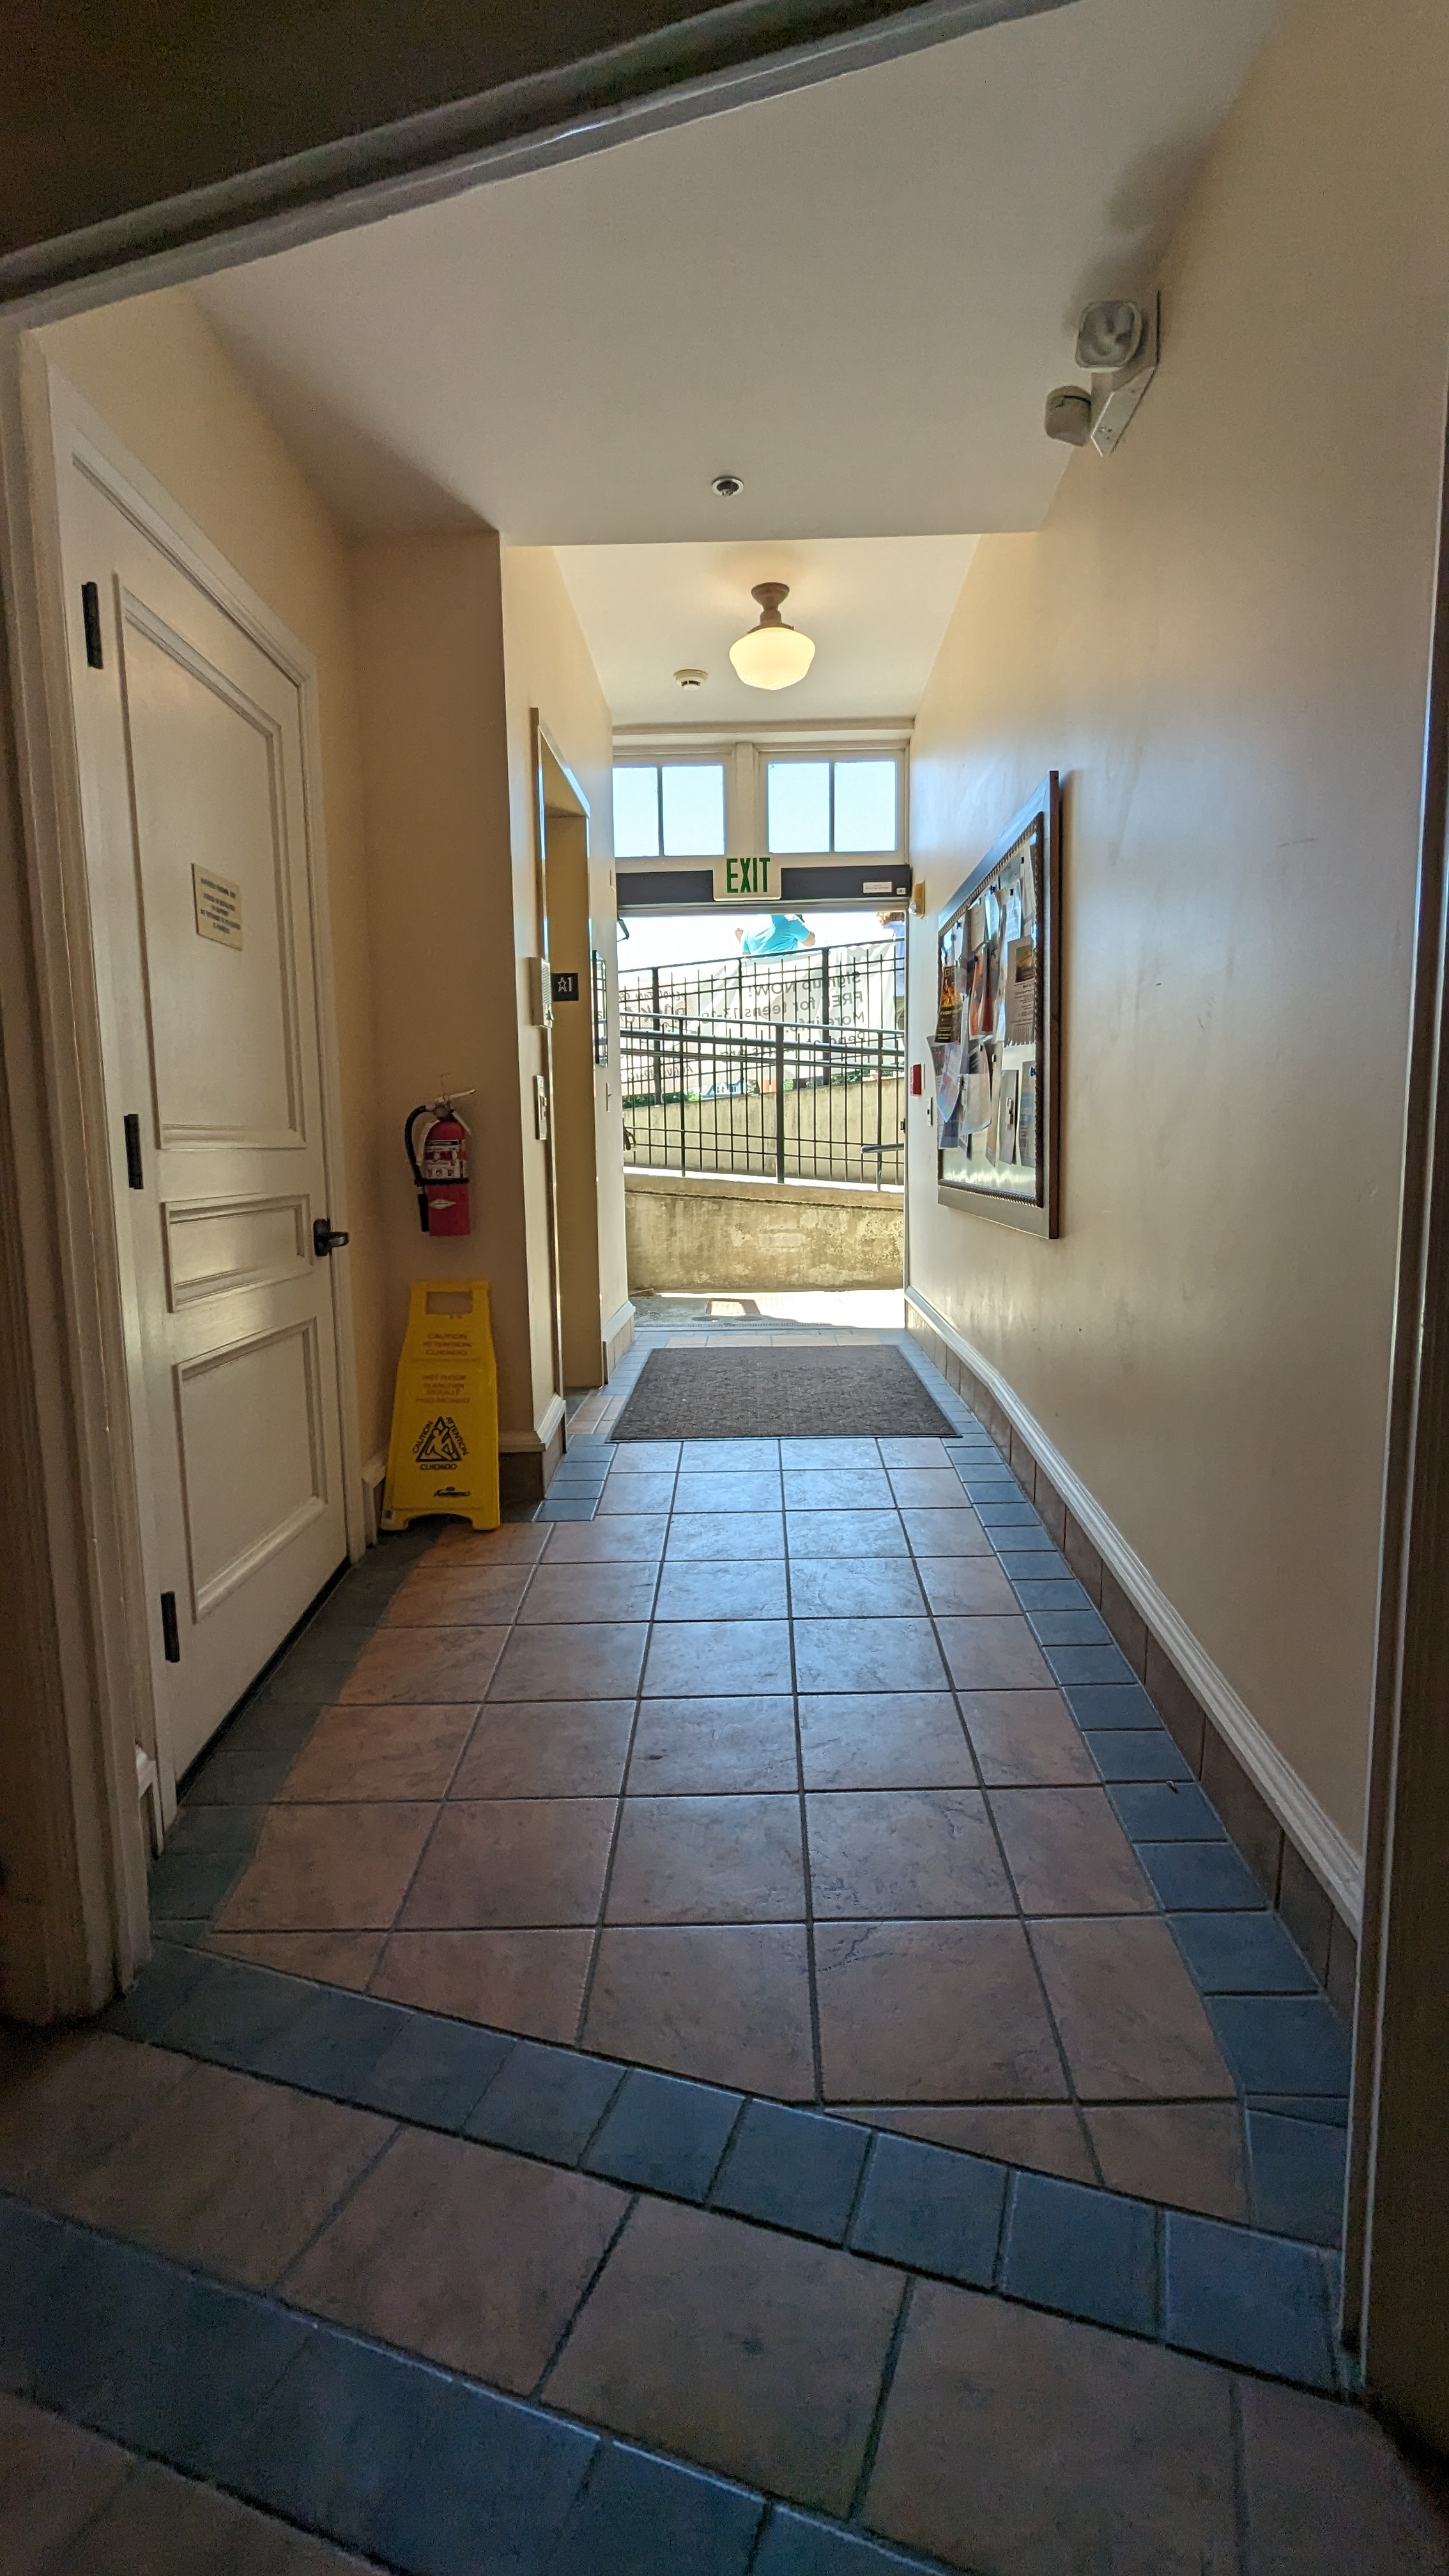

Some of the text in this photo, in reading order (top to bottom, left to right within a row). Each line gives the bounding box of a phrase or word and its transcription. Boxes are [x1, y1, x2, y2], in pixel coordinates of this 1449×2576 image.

[726, 857, 770, 893] EXIT
[413, 1416, 469, 1455] CAUTION ATTENTION
